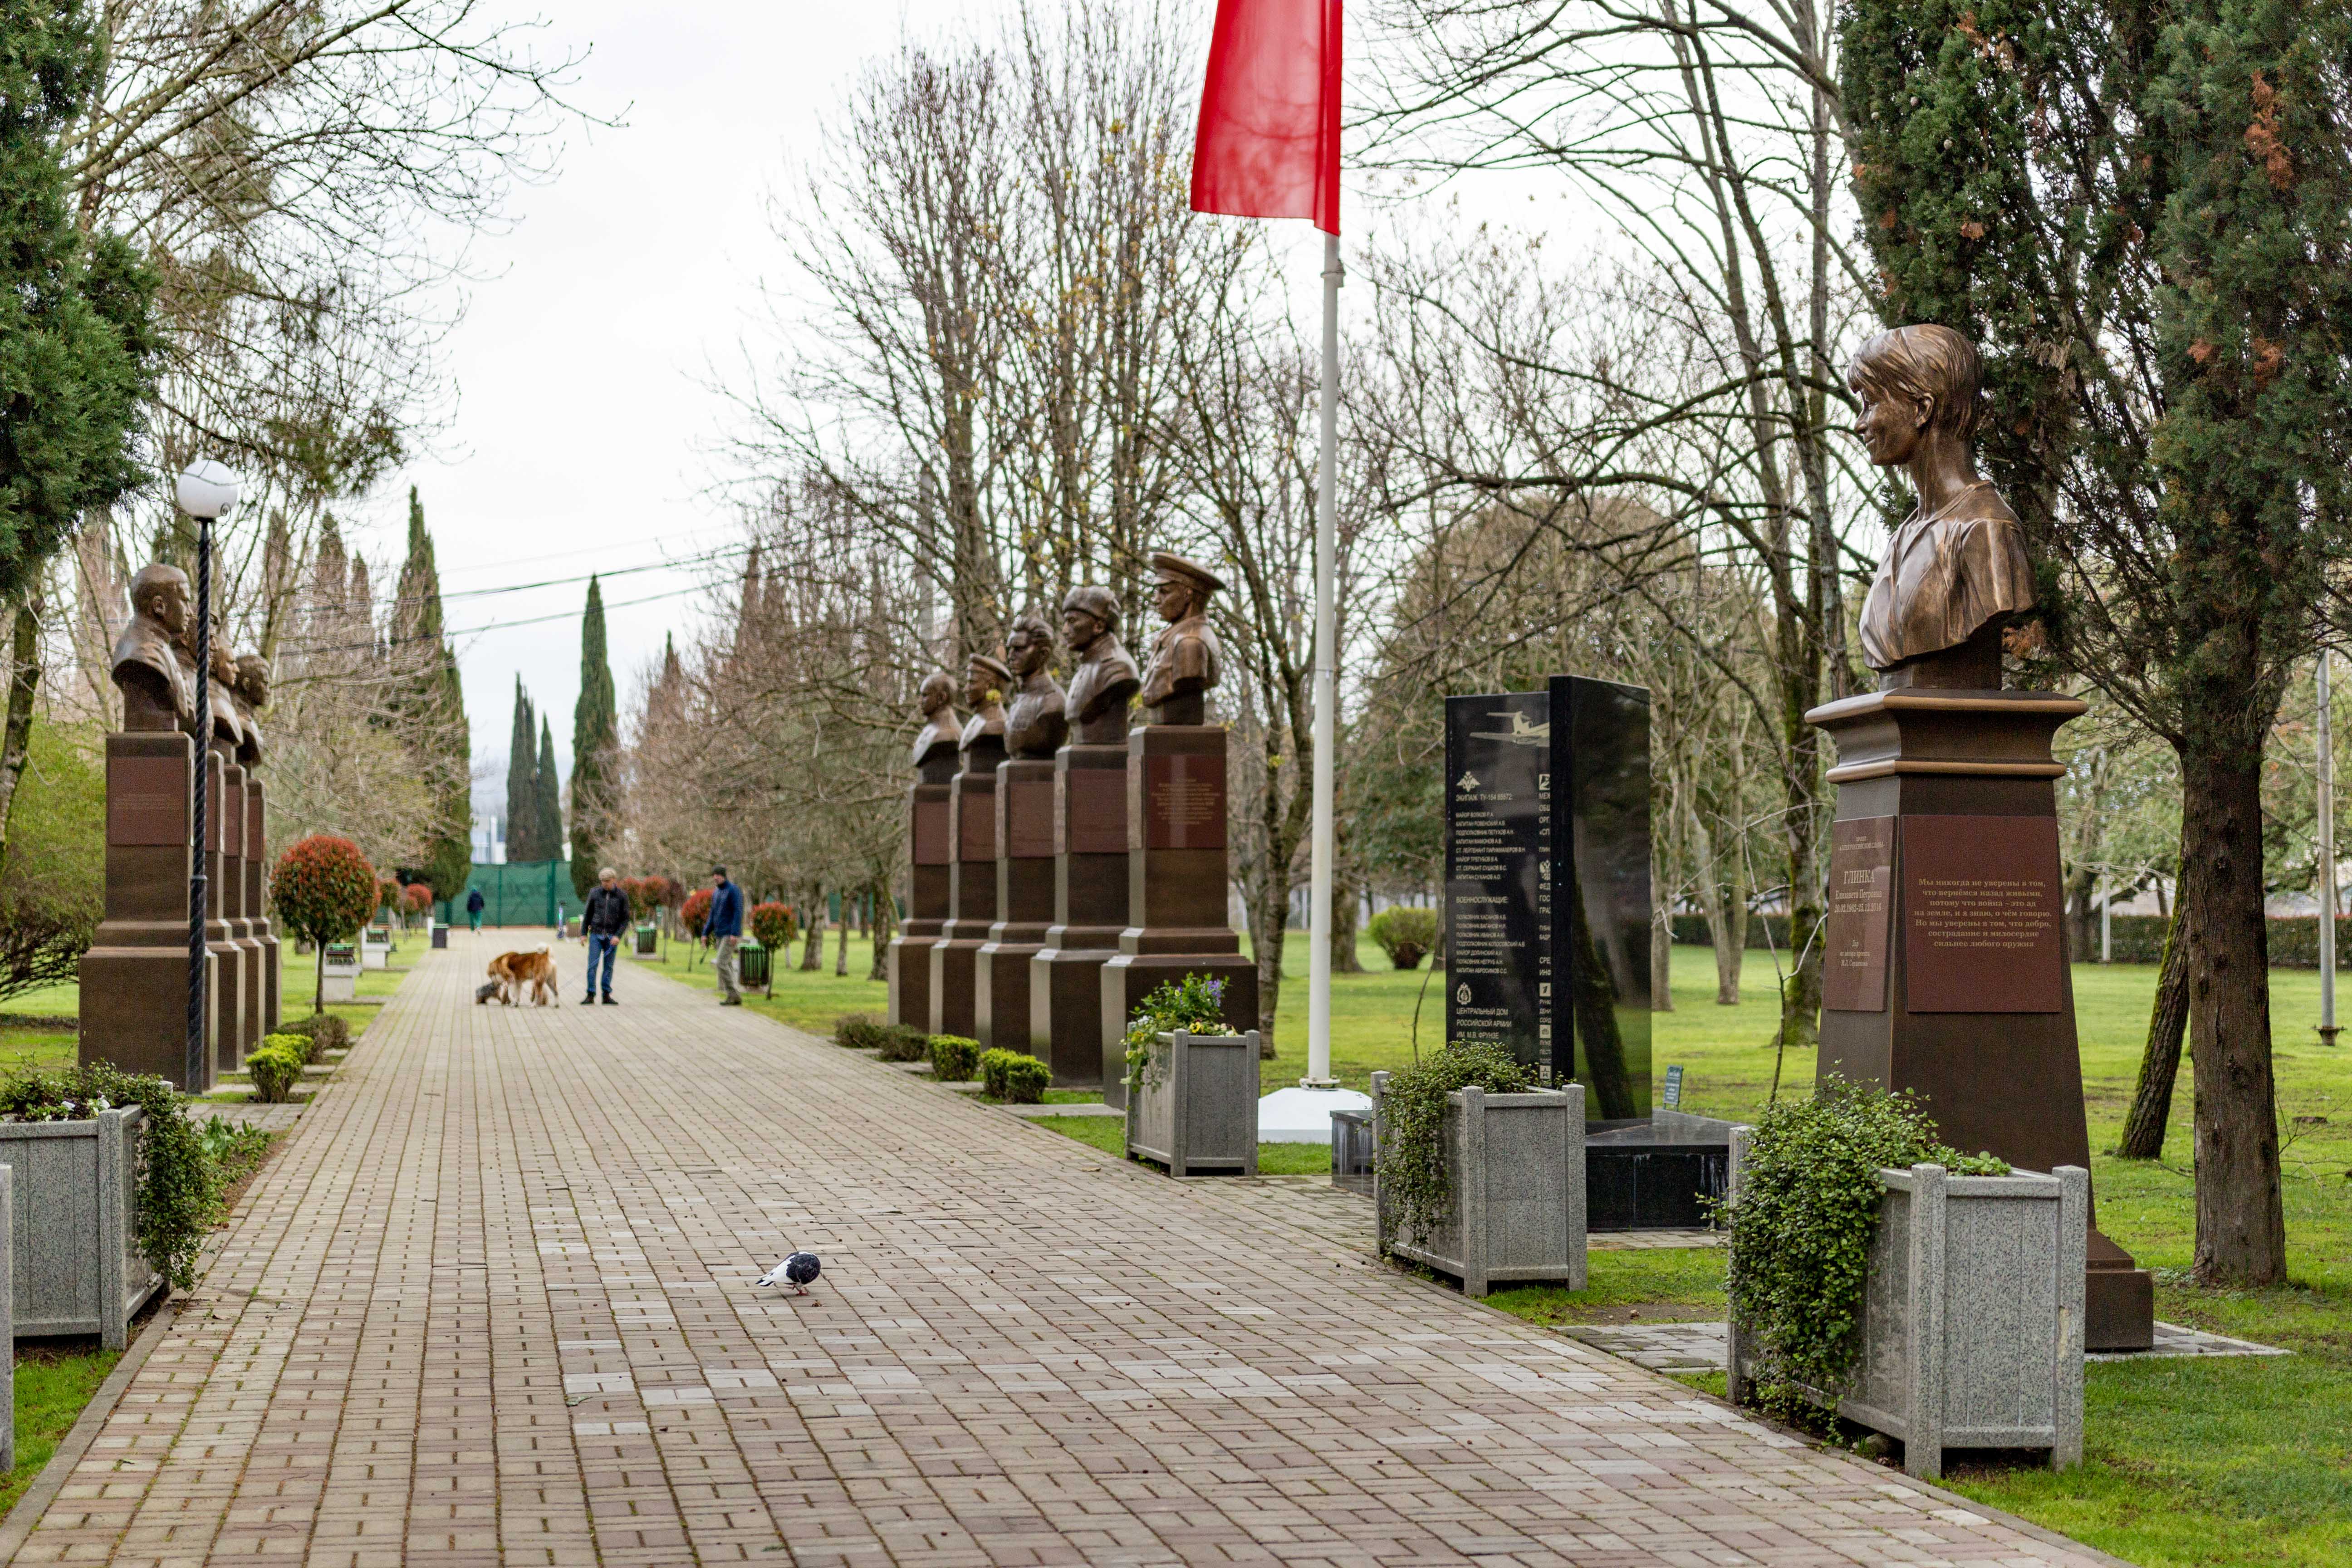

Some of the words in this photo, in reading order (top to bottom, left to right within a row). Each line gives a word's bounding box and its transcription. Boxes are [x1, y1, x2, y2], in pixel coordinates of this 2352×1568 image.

[1843, 869, 1875, 884] ГЛИНКА
[1835, 890, 1858, 900] Елизавета
[1859, 889, 1882, 901] Петровна
[2025, 920, 2051, 929] добро,
[1456, 1007, 1495, 1015] ЦЕНТРАЛЬНЫЙ
[1496, 1008, 1509, 1016] ДОМ
[1456, 1019, 1492, 1027] РОССИЙСКОЙ
